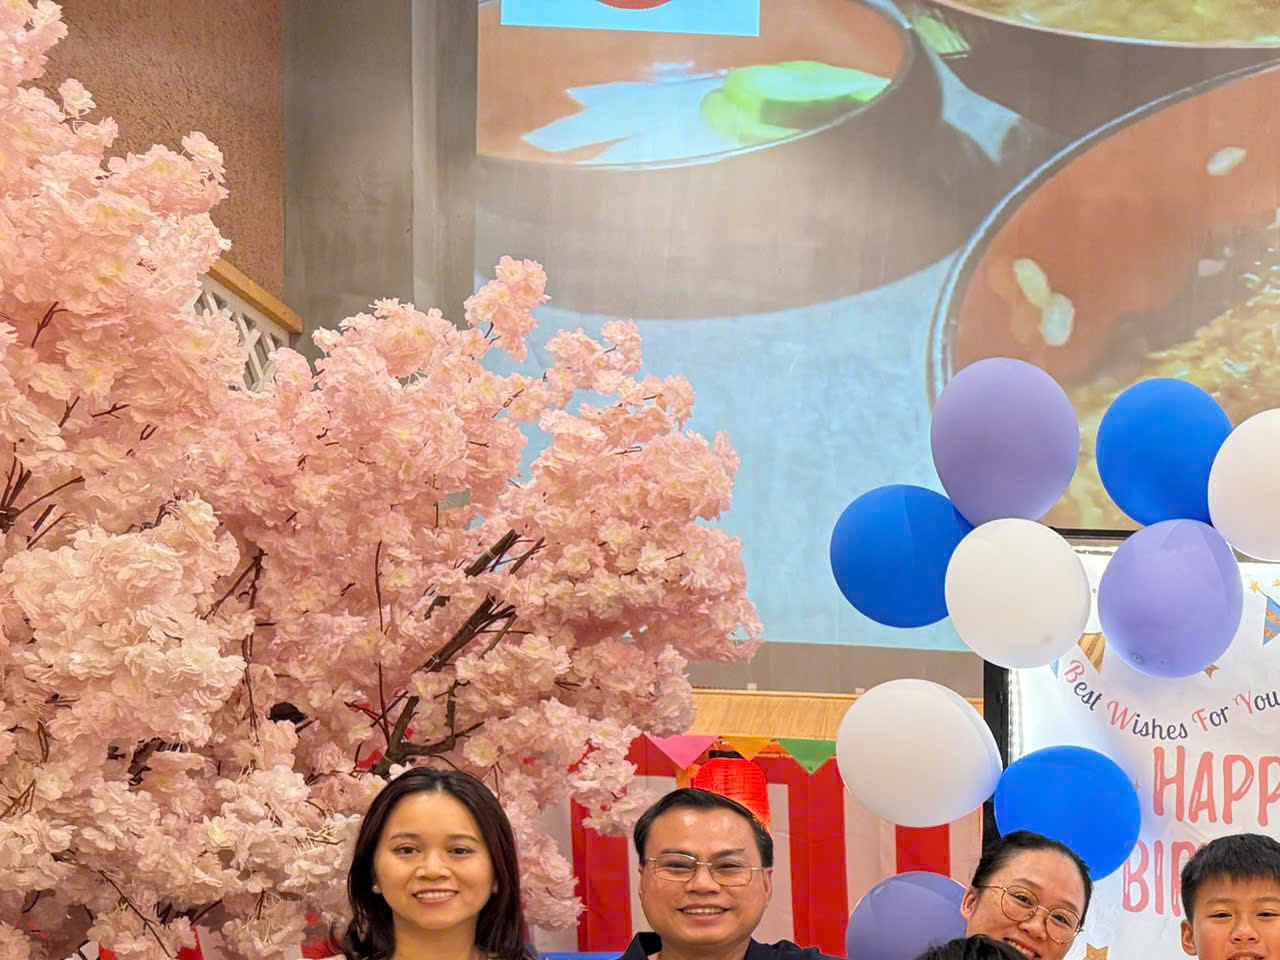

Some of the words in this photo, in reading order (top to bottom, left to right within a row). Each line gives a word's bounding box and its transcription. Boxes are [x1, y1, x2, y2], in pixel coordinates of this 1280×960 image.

[1064, 659, 1101, 711] Best
[1106, 700, 1188, 740] Wishes
[1192, 705, 1229, 732] For
